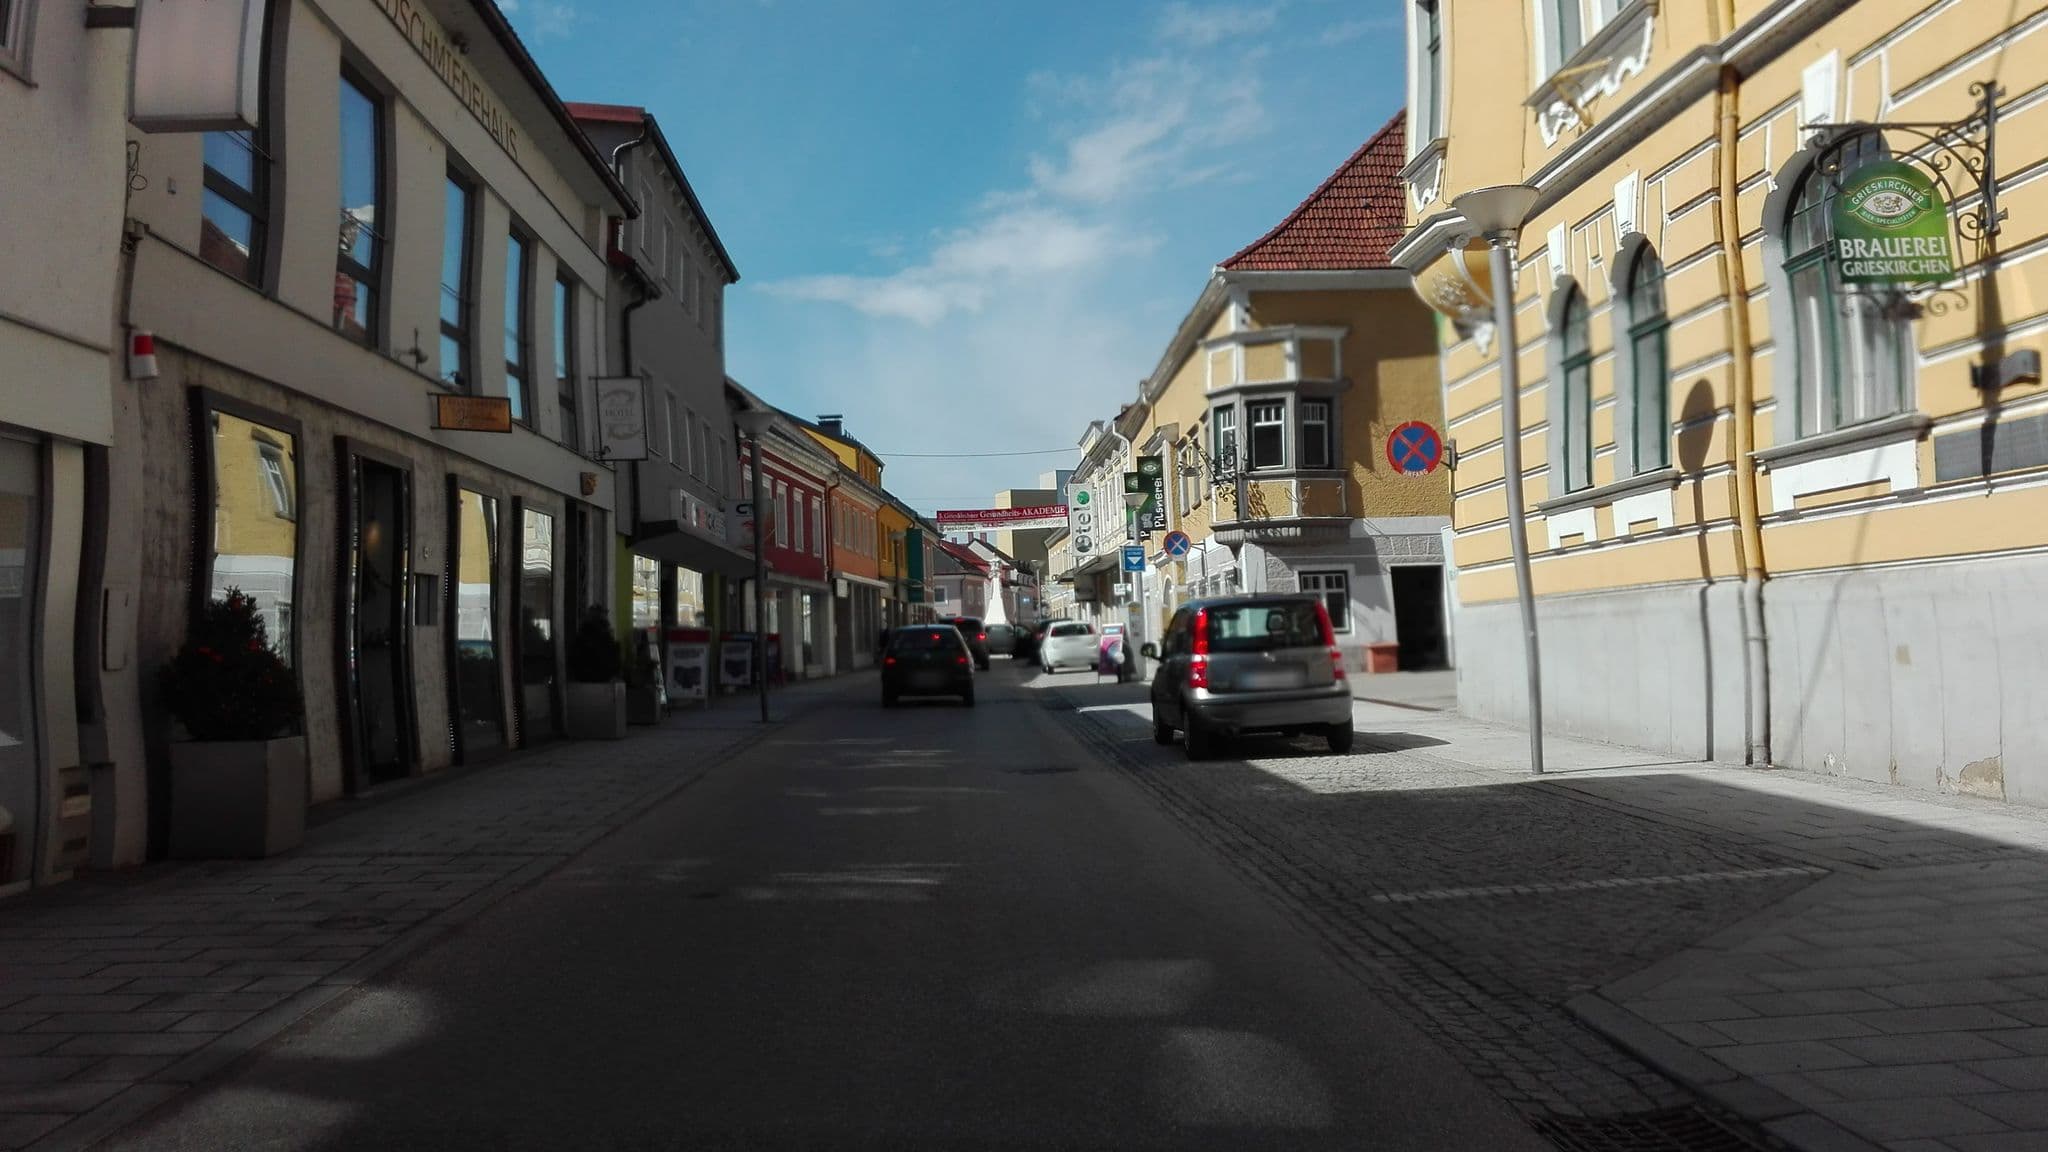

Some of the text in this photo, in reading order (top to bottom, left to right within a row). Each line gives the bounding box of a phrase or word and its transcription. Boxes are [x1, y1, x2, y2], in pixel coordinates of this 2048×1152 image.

[1851, 180, 1924, 206] GRIESKIRCHNER
[1839, 236, 1948, 259] BRAUEREI
[1842, 259, 1951, 277] GRIESKIRCHEN
[1153, 477, 1165, 528] Pilsnerei
